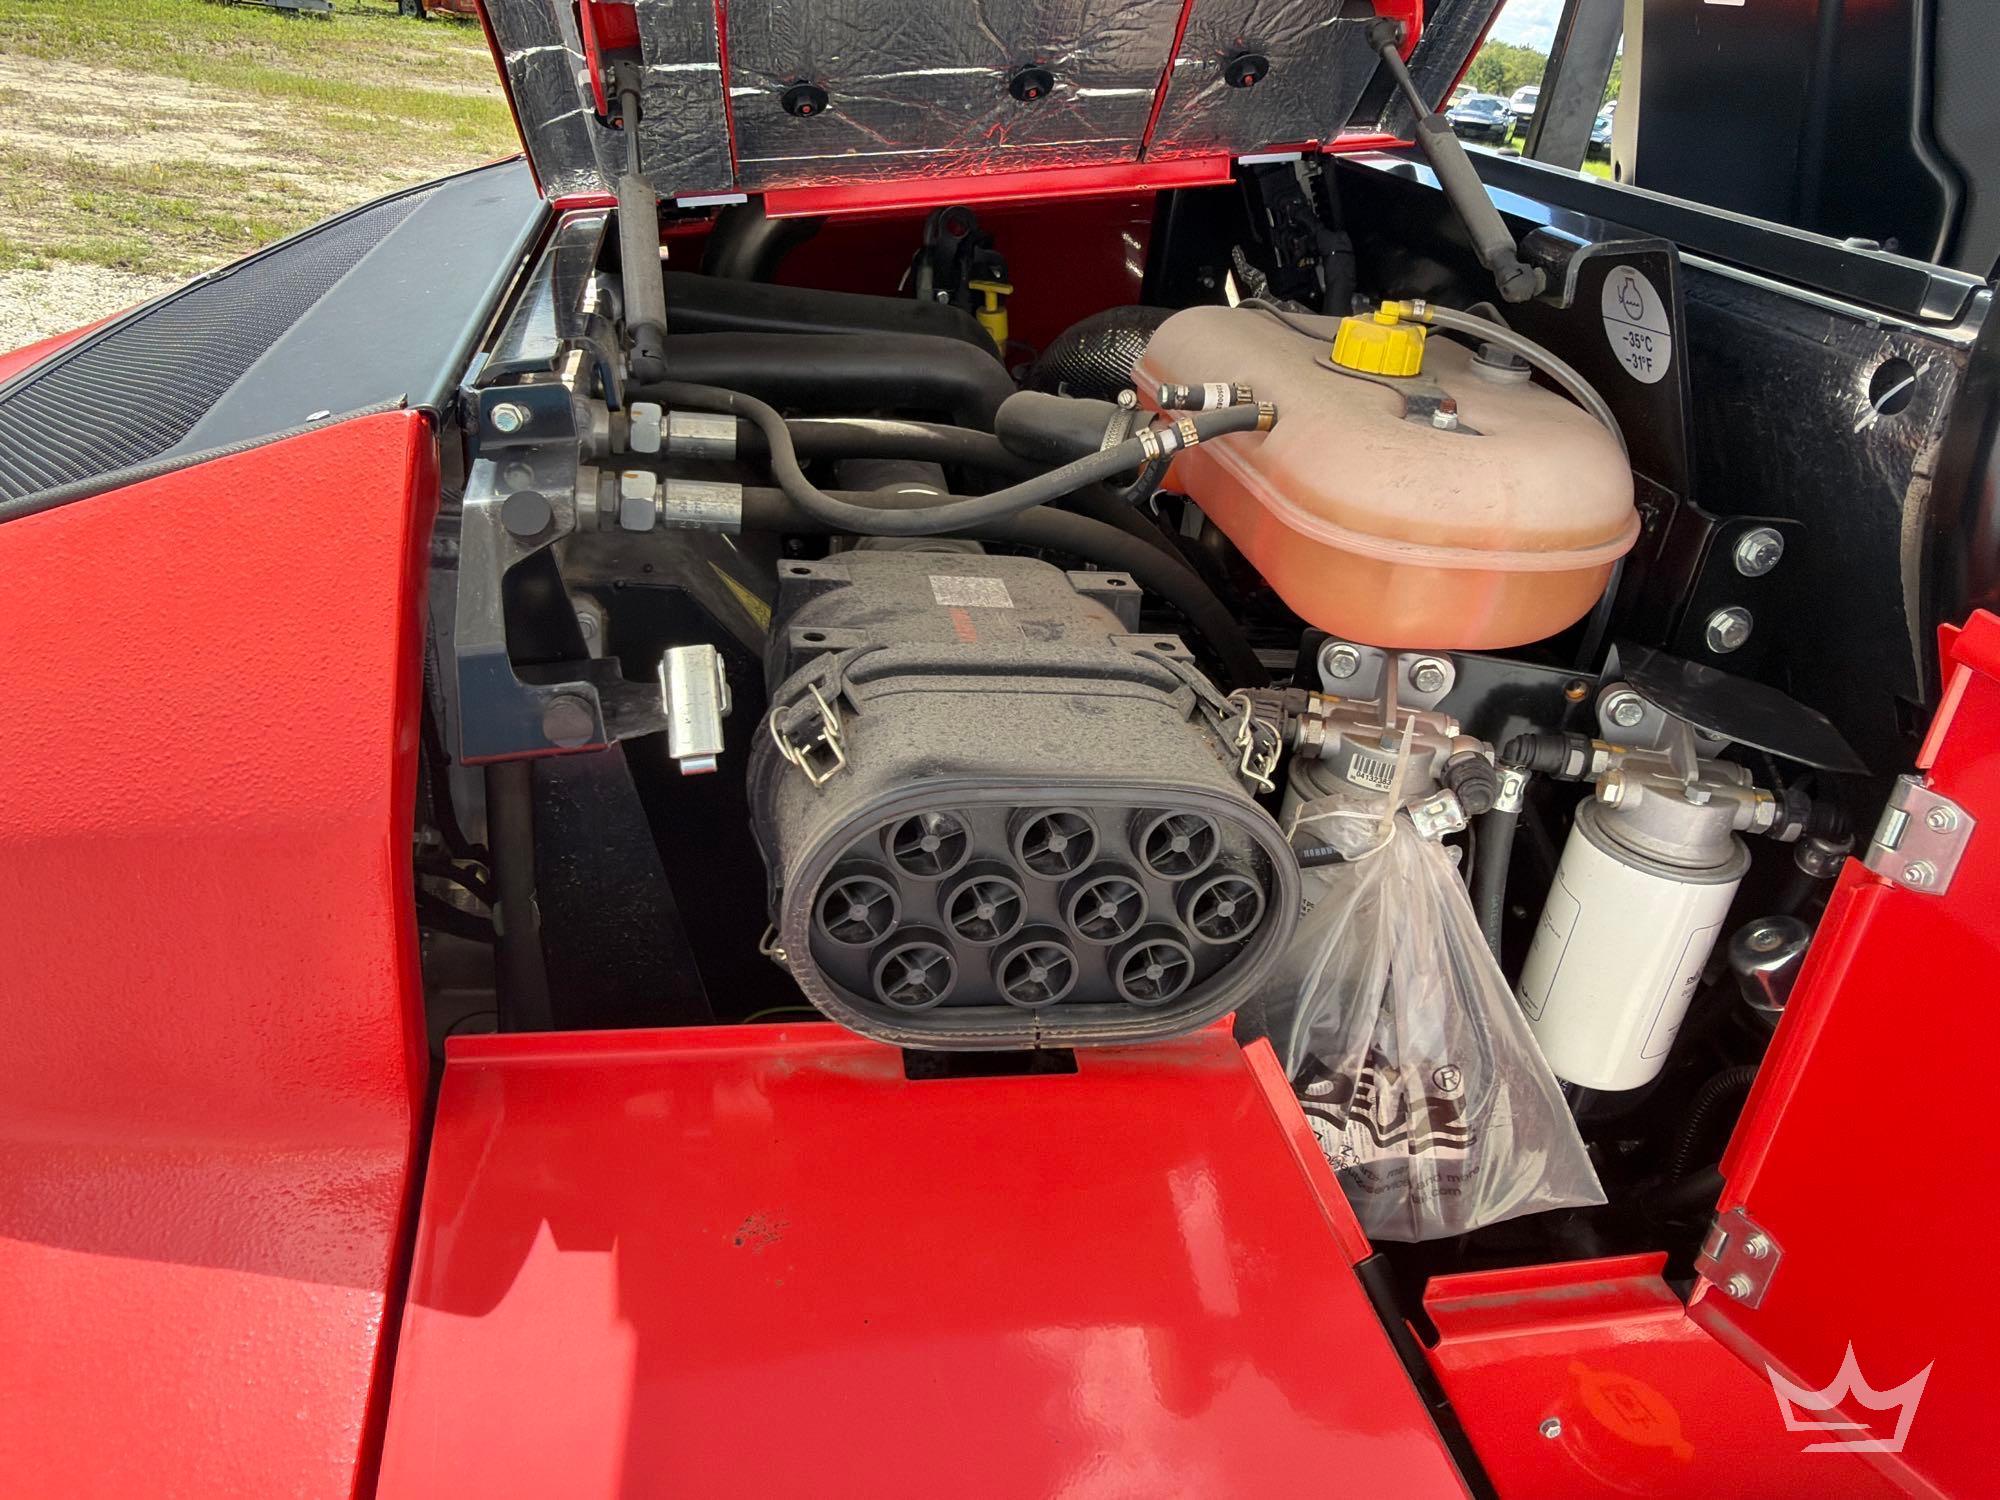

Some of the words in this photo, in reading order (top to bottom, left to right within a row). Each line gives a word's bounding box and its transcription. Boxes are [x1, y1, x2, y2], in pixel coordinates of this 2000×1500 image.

[1622, 331, 1653, 352] -35°C
[1625, 353, 1653, 373] -31°F
[1416, 1171, 1442, 1191] and
[1447, 1165, 1481, 1183] more
